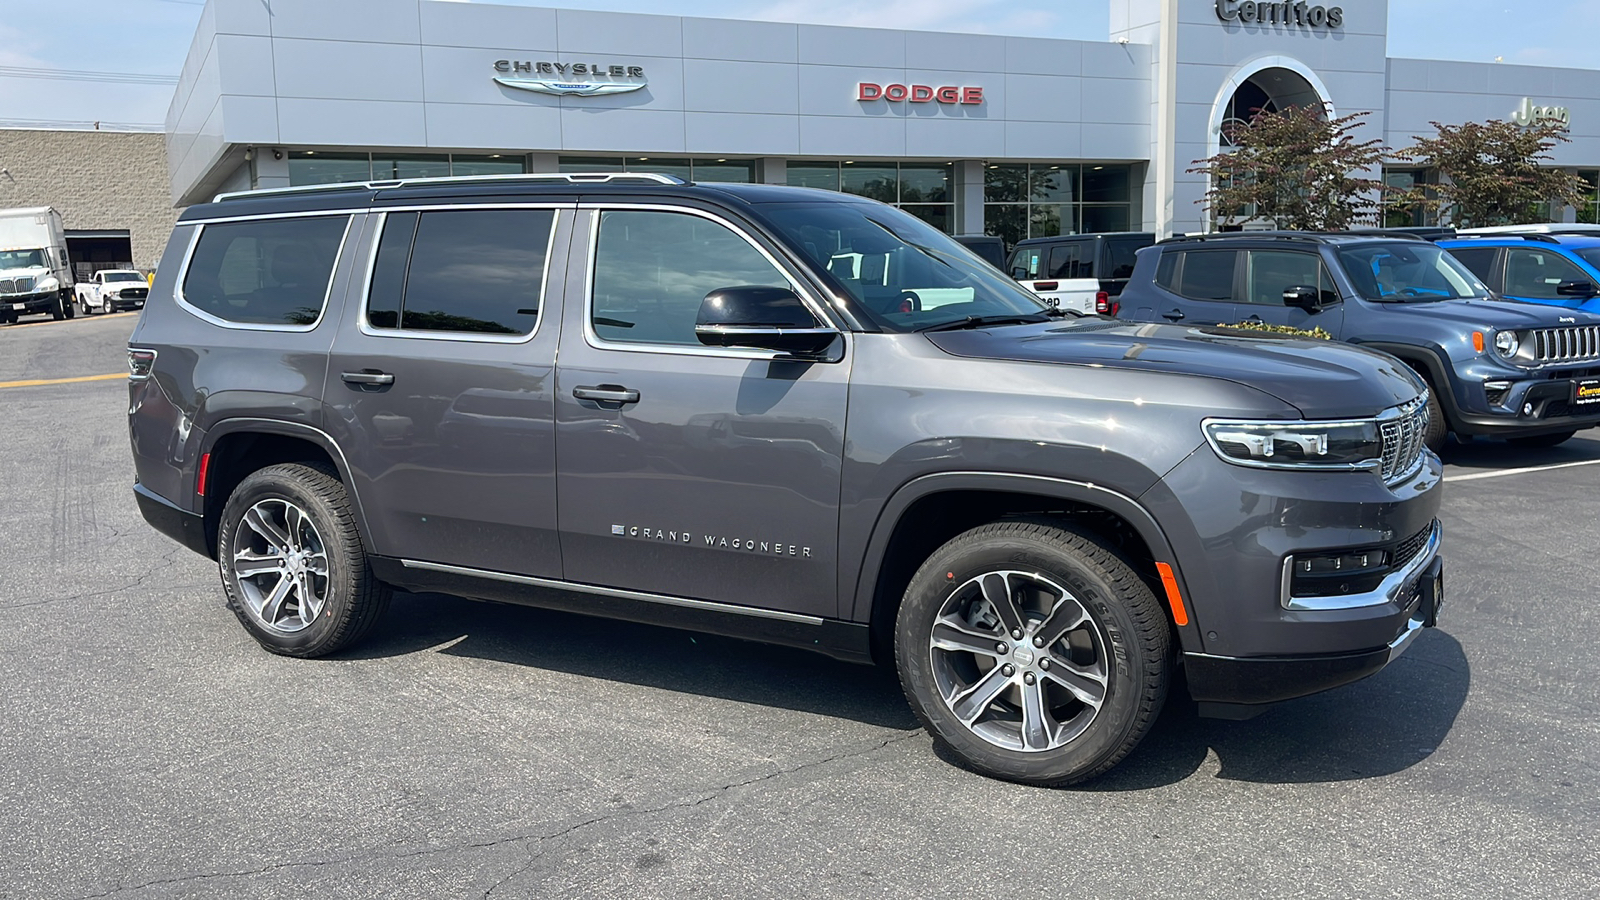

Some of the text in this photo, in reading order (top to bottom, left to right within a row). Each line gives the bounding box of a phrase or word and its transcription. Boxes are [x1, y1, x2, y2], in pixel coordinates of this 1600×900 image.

[1215, 0, 1344, 29] Cerritos
[493, 60, 644, 78] CHRYSLER
[857, 82, 985, 105] DODGE
[1512, 96, 1570, 128] Jeep
[629, 526, 812, 558] GRAND WAGONEER
